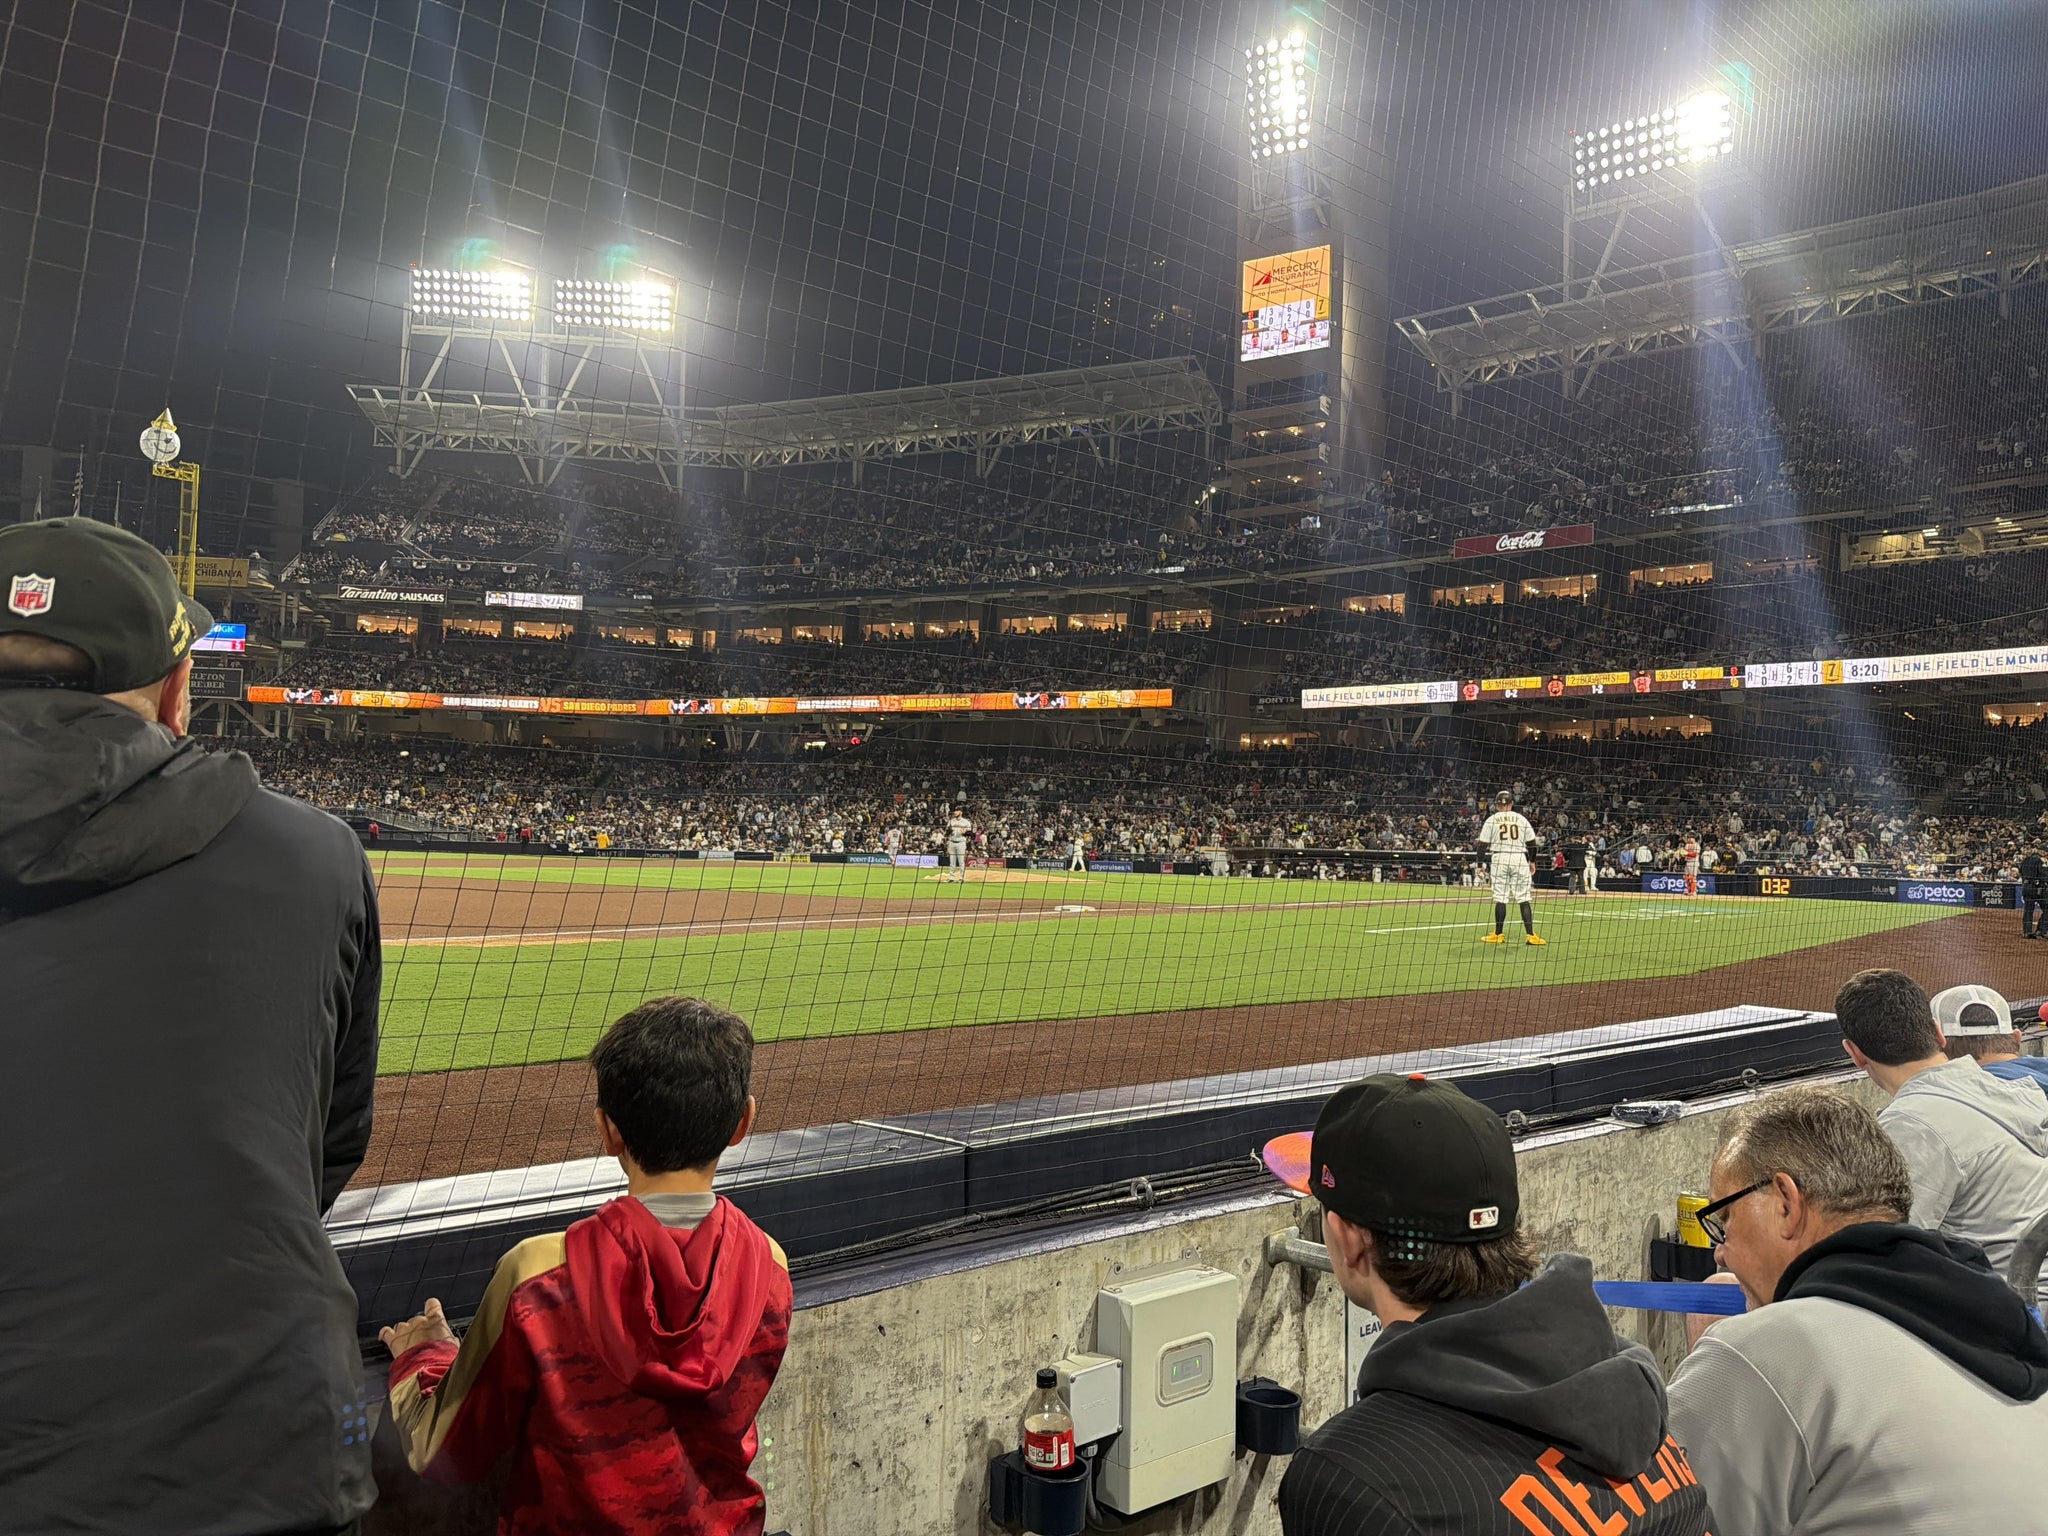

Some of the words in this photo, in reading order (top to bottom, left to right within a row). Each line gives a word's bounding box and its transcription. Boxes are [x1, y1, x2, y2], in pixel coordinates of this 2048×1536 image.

[1273, 260, 1319, 276] MERCURY
[1273, 269, 1319, 283] INSURANCE
[1977, 461, 2015, 475] STEVE
[1496, 530, 1546, 551] Coca-Cola
[340, 586, 398, 600] Tarantino
[400, 592, 445, 602] SAUSAGES
[1828, 663, 1835, 677] 7
[1852, 664, 1879, 677] 8:20
[1892, 661, 1930, 673] LANE
[1937, 659, 1978, 671] FIELD
[1670, 669, 1697, 679] SHEETS
[1592, 685, 1603, 694] 1-2
[1682, 680, 1696, 689] 0-2
[1306, 693, 1330, 702] LANE
[1334, 691, 1362, 701] FIELD
[1365, 689, 1419, 699] LEMONADE
[1505, 689, 1518, 698] 0-2
[442, 696, 460, 706] SAN
[461, 697, 507, 708] FRANCISCO
[508, 698, 539, 709] GIANTS
[540, 697, 561, 713] VS
[563, 702, 581, 711] SAN
[582, 702, 606, 711] DIEGO
[607, 703, 637, 712] PADRES
[811, 699, 850, 709] FRANCISCO
[852, 698, 880, 708] GIANTS
[901, 698, 917, 708] SAN
[917, 697, 940, 708] DIEGO
[941, 697, 972, 707] PADRES
[1499, 824, 1518, 840] 20
[1667, 878, 1706, 890] peo
[1762, 878, 1790, 894] 032
[1925, 885, 1965, 899] petco
[1981, 889, 2003, 899] petco
[1985, 896, 2003, 905] park
